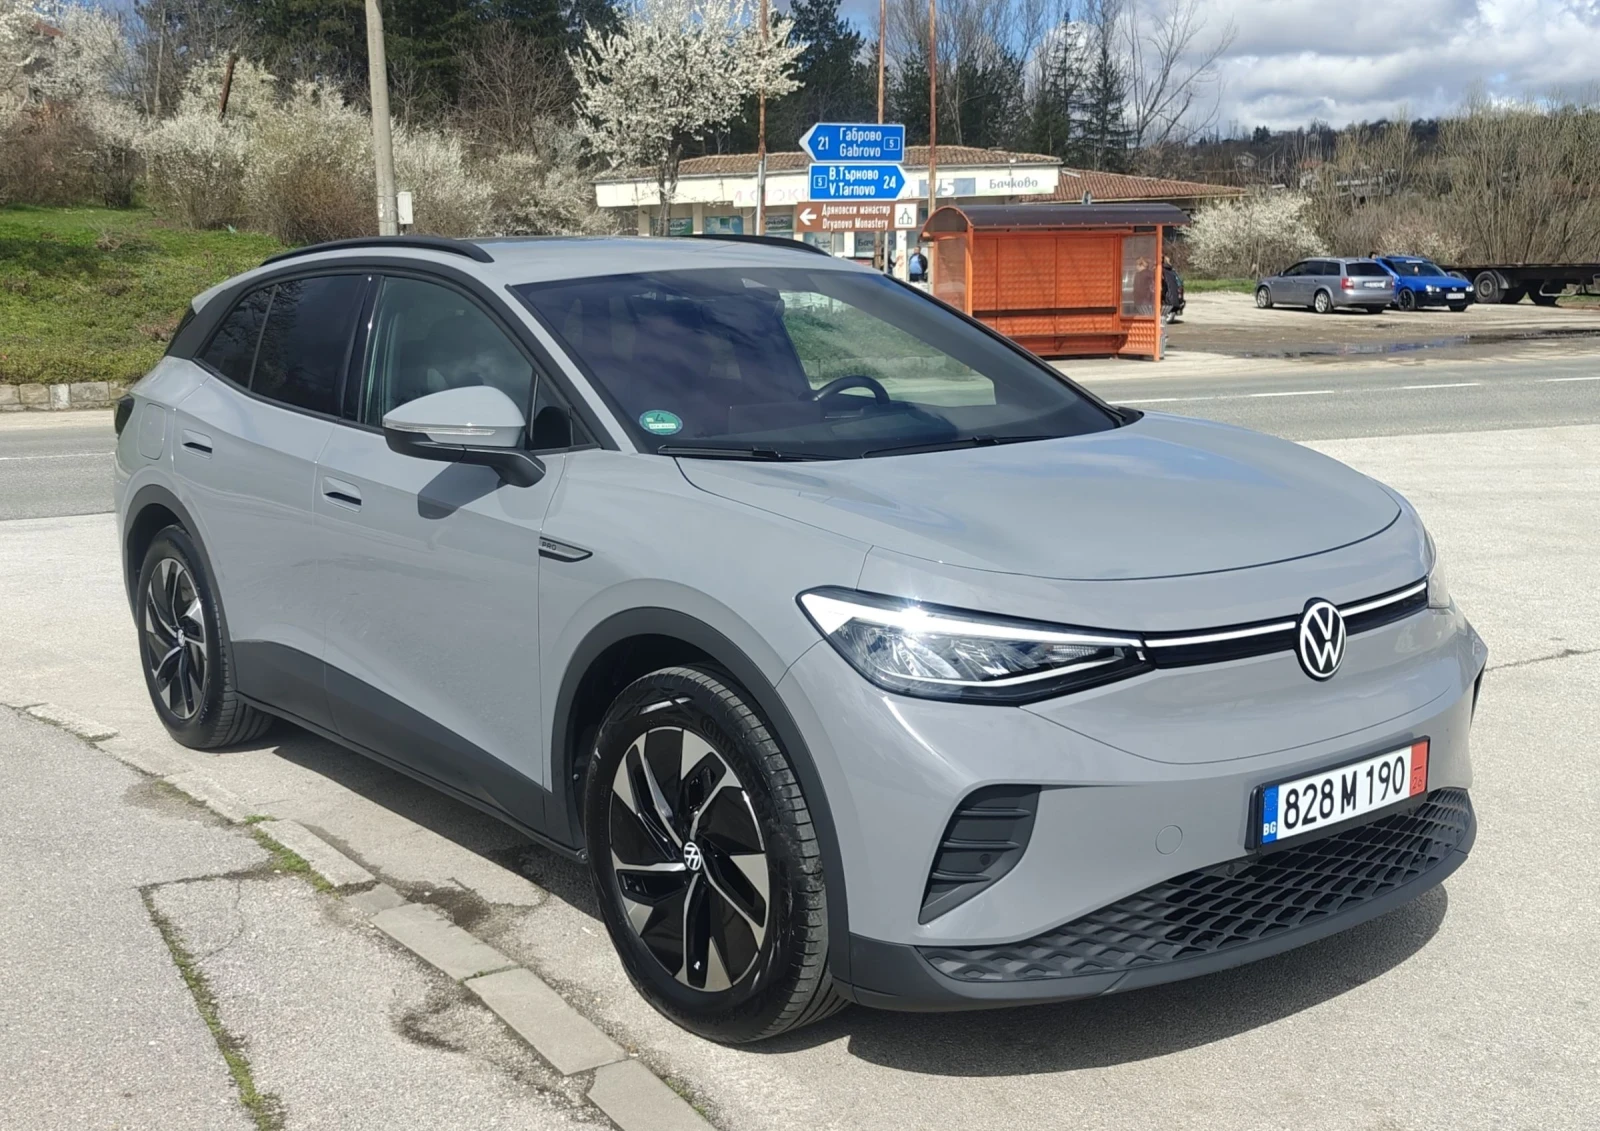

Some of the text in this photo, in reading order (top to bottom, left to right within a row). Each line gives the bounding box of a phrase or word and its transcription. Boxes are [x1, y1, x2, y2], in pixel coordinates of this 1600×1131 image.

[839, 127, 882, 144] Габрово
[817, 136, 829, 150] 21
[889, 138, 895, 148] 5
[839, 143, 881, 158] Gabrovo
[828, 166, 879, 183] В.Търново
[817, 177, 823, 187] 5
[883, 175, 897, 189] 24
[989, 177, 1038, 190] Бачково
[828, 182, 876, 197] V.Tarnovo
[859, 204, 891, 217] манастир
[822, 217, 889, 232] Dryanovo Monastery
[541, 541, 557, 551] PRO
[1283, 755, 1406, 830] 828 M 190
[1262, 821, 1277, 836] BG
